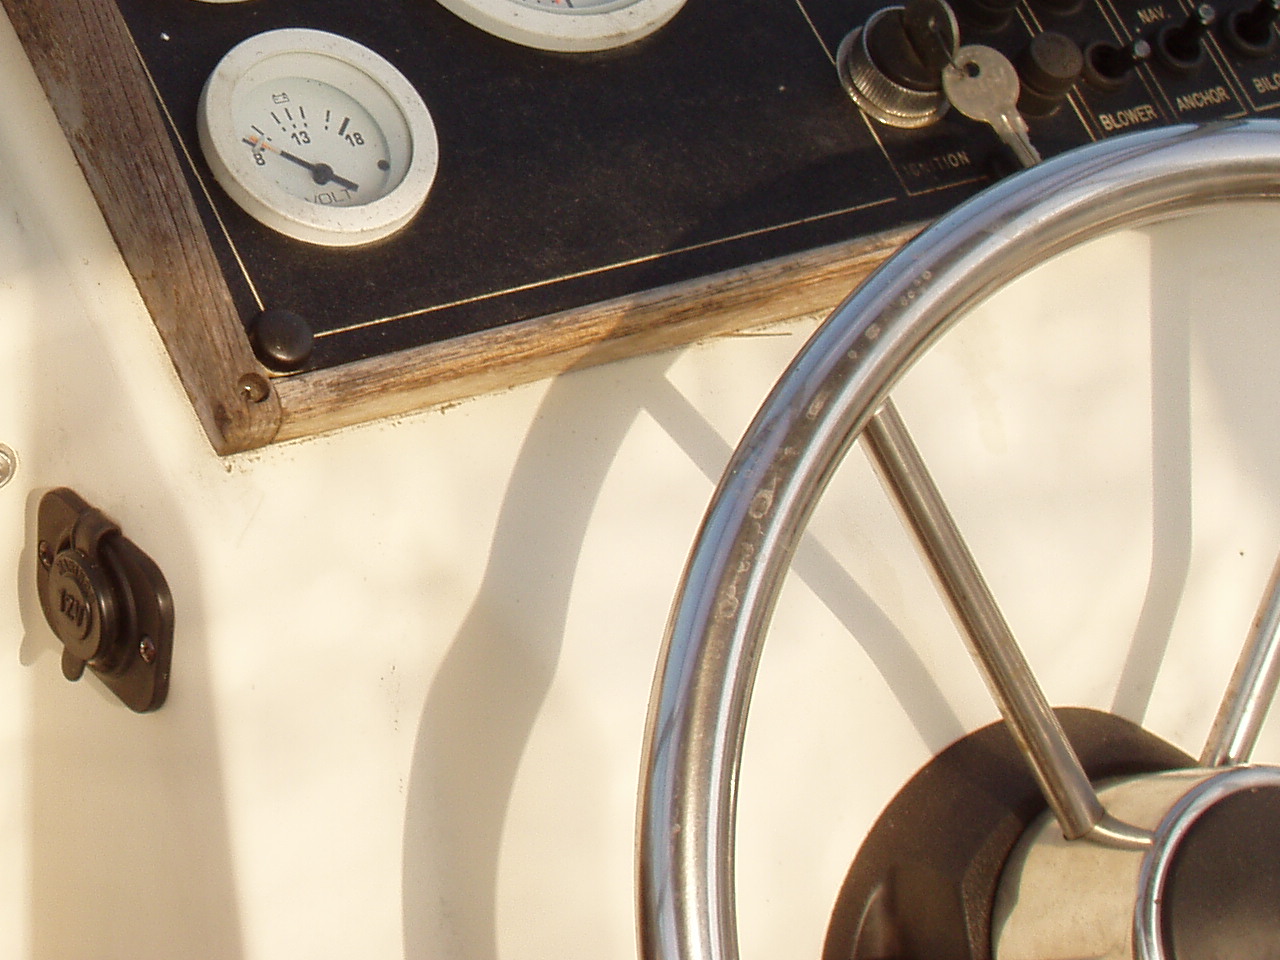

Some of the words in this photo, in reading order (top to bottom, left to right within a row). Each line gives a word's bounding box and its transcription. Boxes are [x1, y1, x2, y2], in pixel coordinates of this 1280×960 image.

[1176, 85, 1231, 112] ANCHOR
[1099, 104, 1158, 130] BLOWER
[291, 130, 311, 146] 13
[345, 132, 365, 147] 18
[903, 151, 971, 176] IGTION
